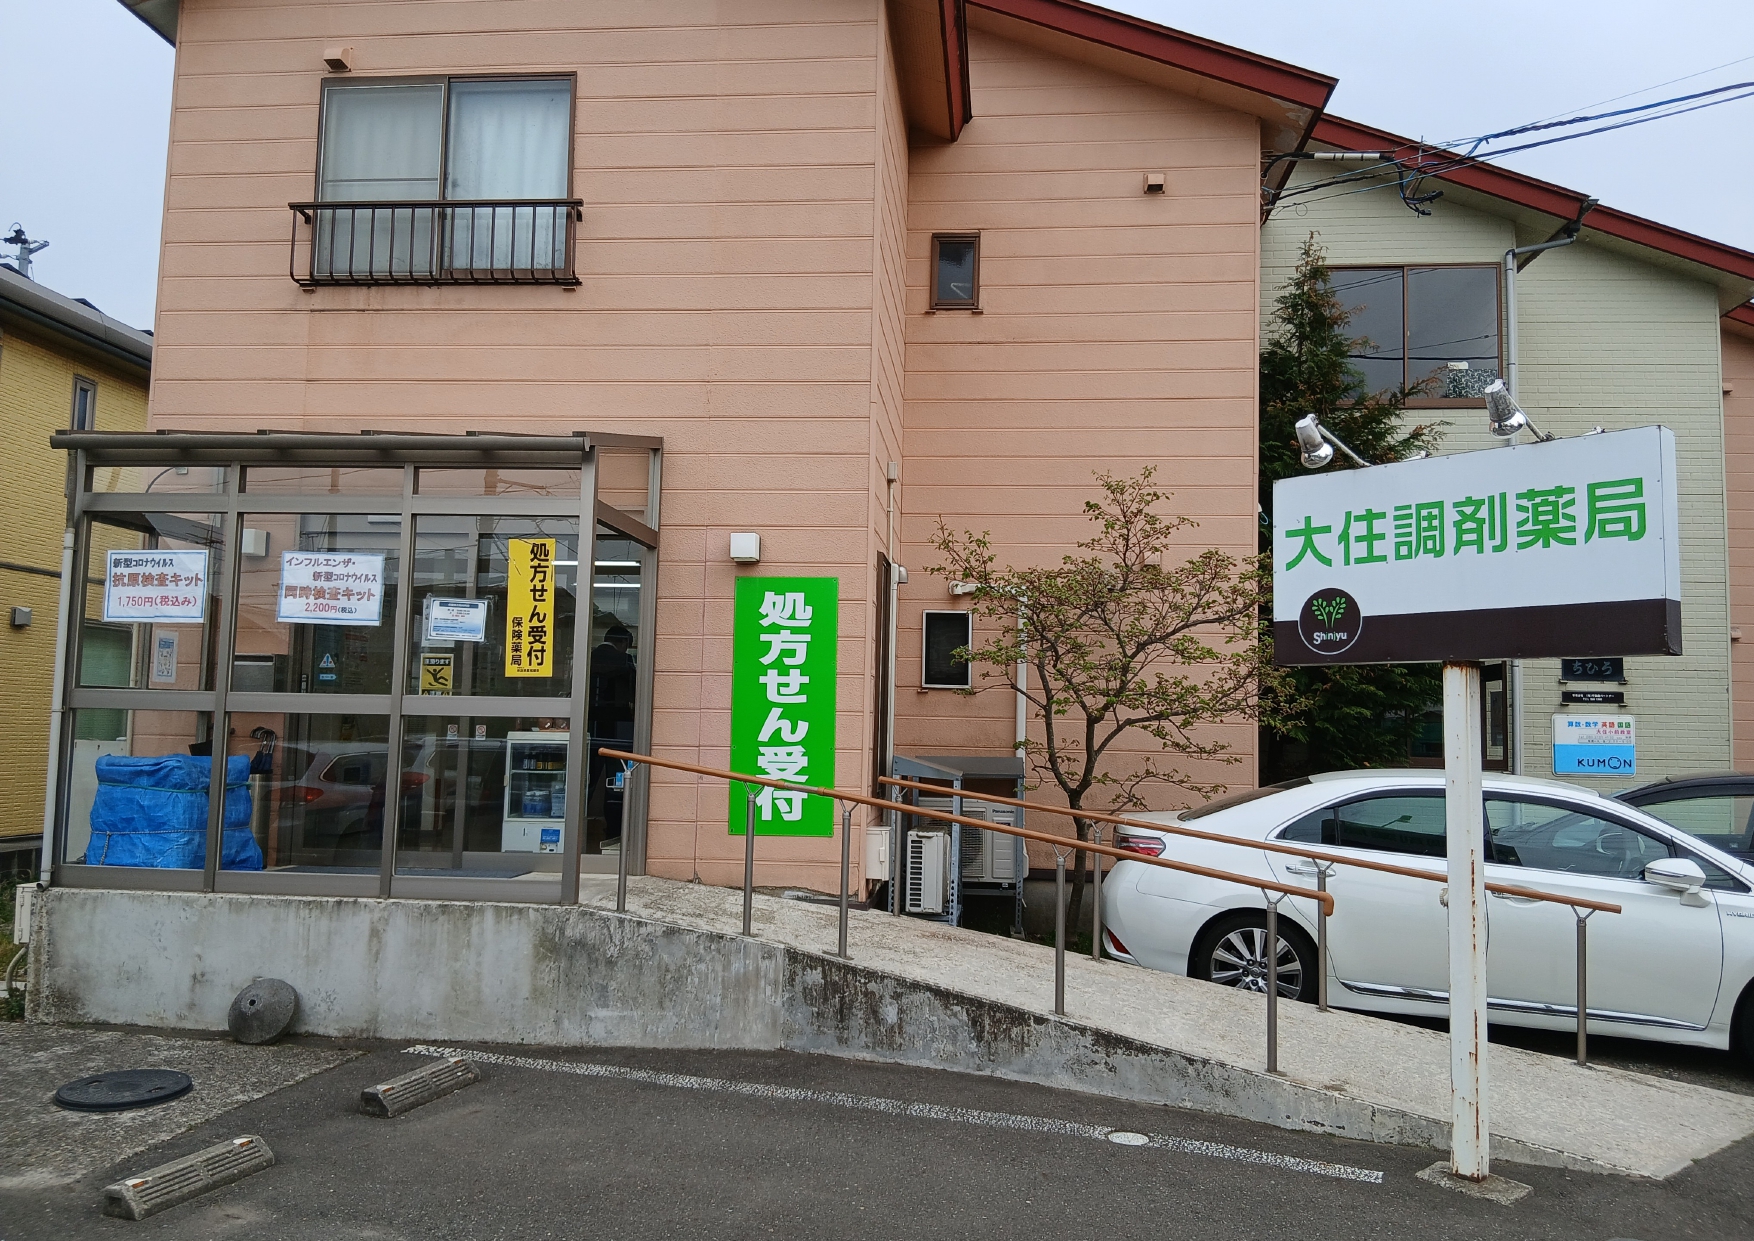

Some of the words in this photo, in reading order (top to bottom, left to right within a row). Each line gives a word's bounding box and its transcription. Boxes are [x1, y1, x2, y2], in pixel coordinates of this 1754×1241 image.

[1285, 477, 1647, 572] 大住調剤薬局
[112, 557, 175, 568] 新型コロナウイルス
[112, 572, 203, 587] 抗原検査キット
[312, 571, 378, 583] 新型コロナウイルス
[284, 585, 376, 602] 同時検査キット
[527, 543, 549, 666] 処方せん受付
[510, 616, 523, 666] 保険薬局
[1313, 631, 1348, 645] Shinjyu
[1572, 660, 1613, 675] ちひろ
[755, 591, 813, 821] 処方せん受付
[1577, 756, 1632, 769] KUMON
